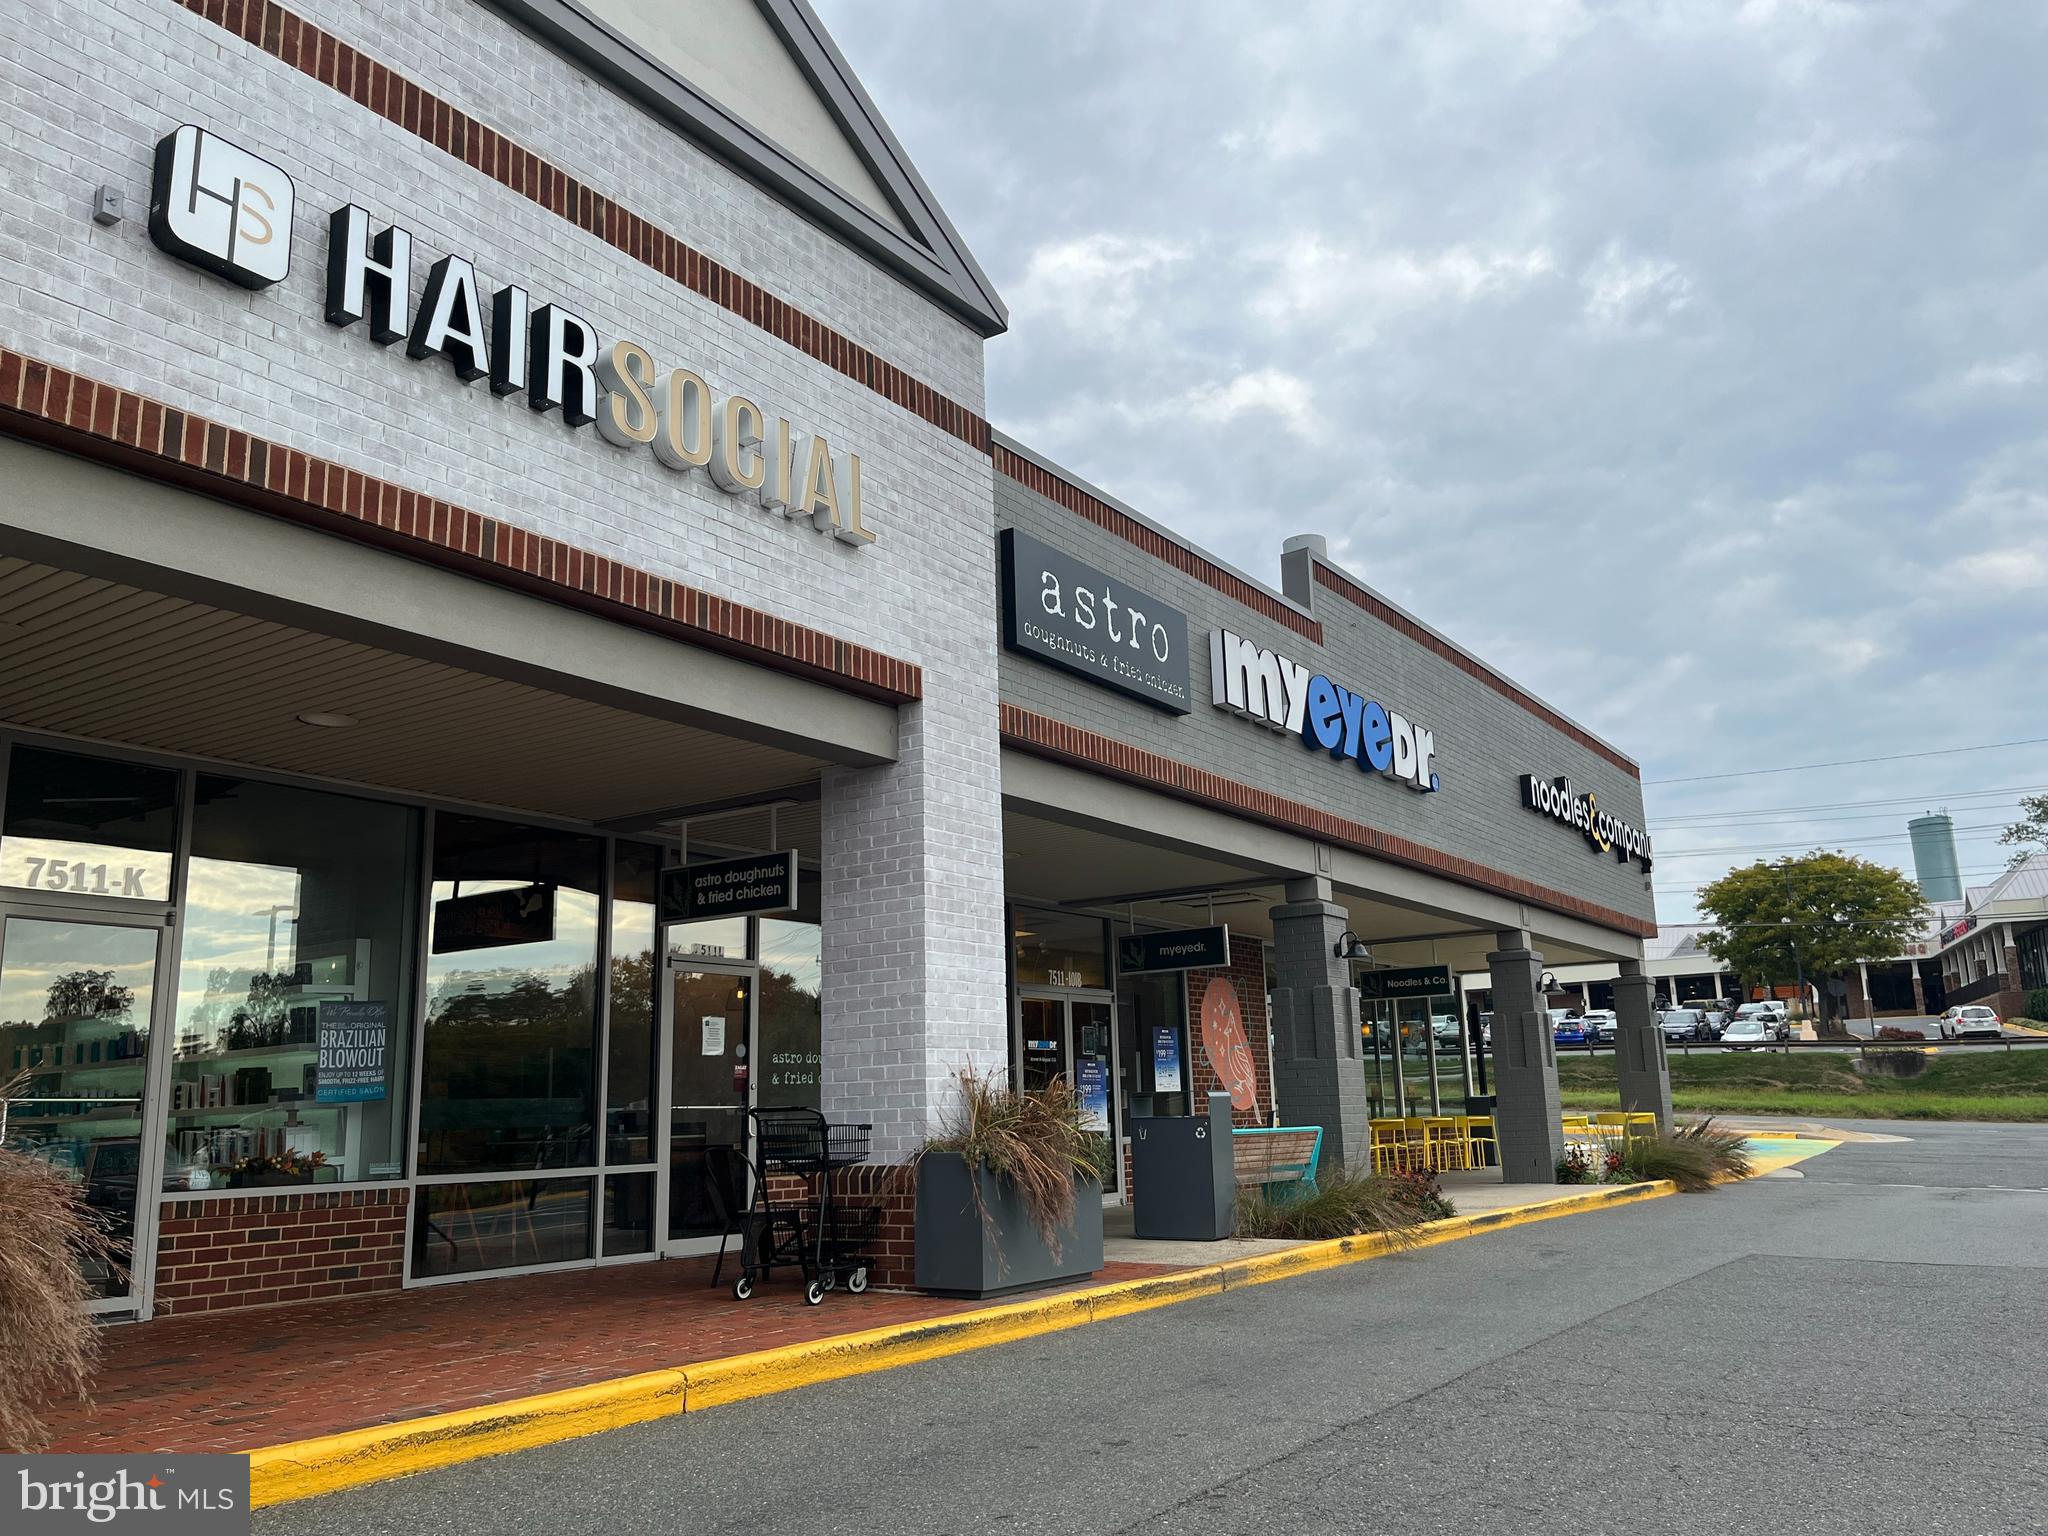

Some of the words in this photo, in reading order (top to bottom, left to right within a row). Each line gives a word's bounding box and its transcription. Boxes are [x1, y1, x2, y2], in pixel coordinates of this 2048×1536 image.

[328, 203, 598, 426] HAIR
[602, 340, 877, 545] SOCIAL
[1041, 570, 1169, 663] astro
[1024, 618, 1096, 663] doughnuts
[1100, 653, 1108, 668] &
[1113, 655, 1143, 682] fried
[1145, 671, 1185, 699] chicken
[1530, 775, 1590, 831] noodles
[1598, 810, 1655, 873] company
[24, 857, 146, 897] 7511-K
[694, 873, 722, 888] astro
[724, 863, 785, 884] doughnuts
[697, 892, 706, 905] &
[708, 888, 733, 904] fried
[735, 884, 781, 900] chicken
[1387, 978, 1423, 988] Noodles
[1424, 976, 1431, 985] &
[1432, 976, 1448, 985] Co.
[350, 1021, 386, 1029] ORIGINAL
[320, 1028, 386, 1048] BRAZILIAN
[319, 1047, 385, 1068] BLOWOUT
[772, 1053, 803, 1064] astro
[772, 1073, 780, 1085] &
[784, 1071, 814, 1084] fried
[317, 1088, 356, 1096] CERTIFIED
[359, 1086, 384, 1094] SALON
